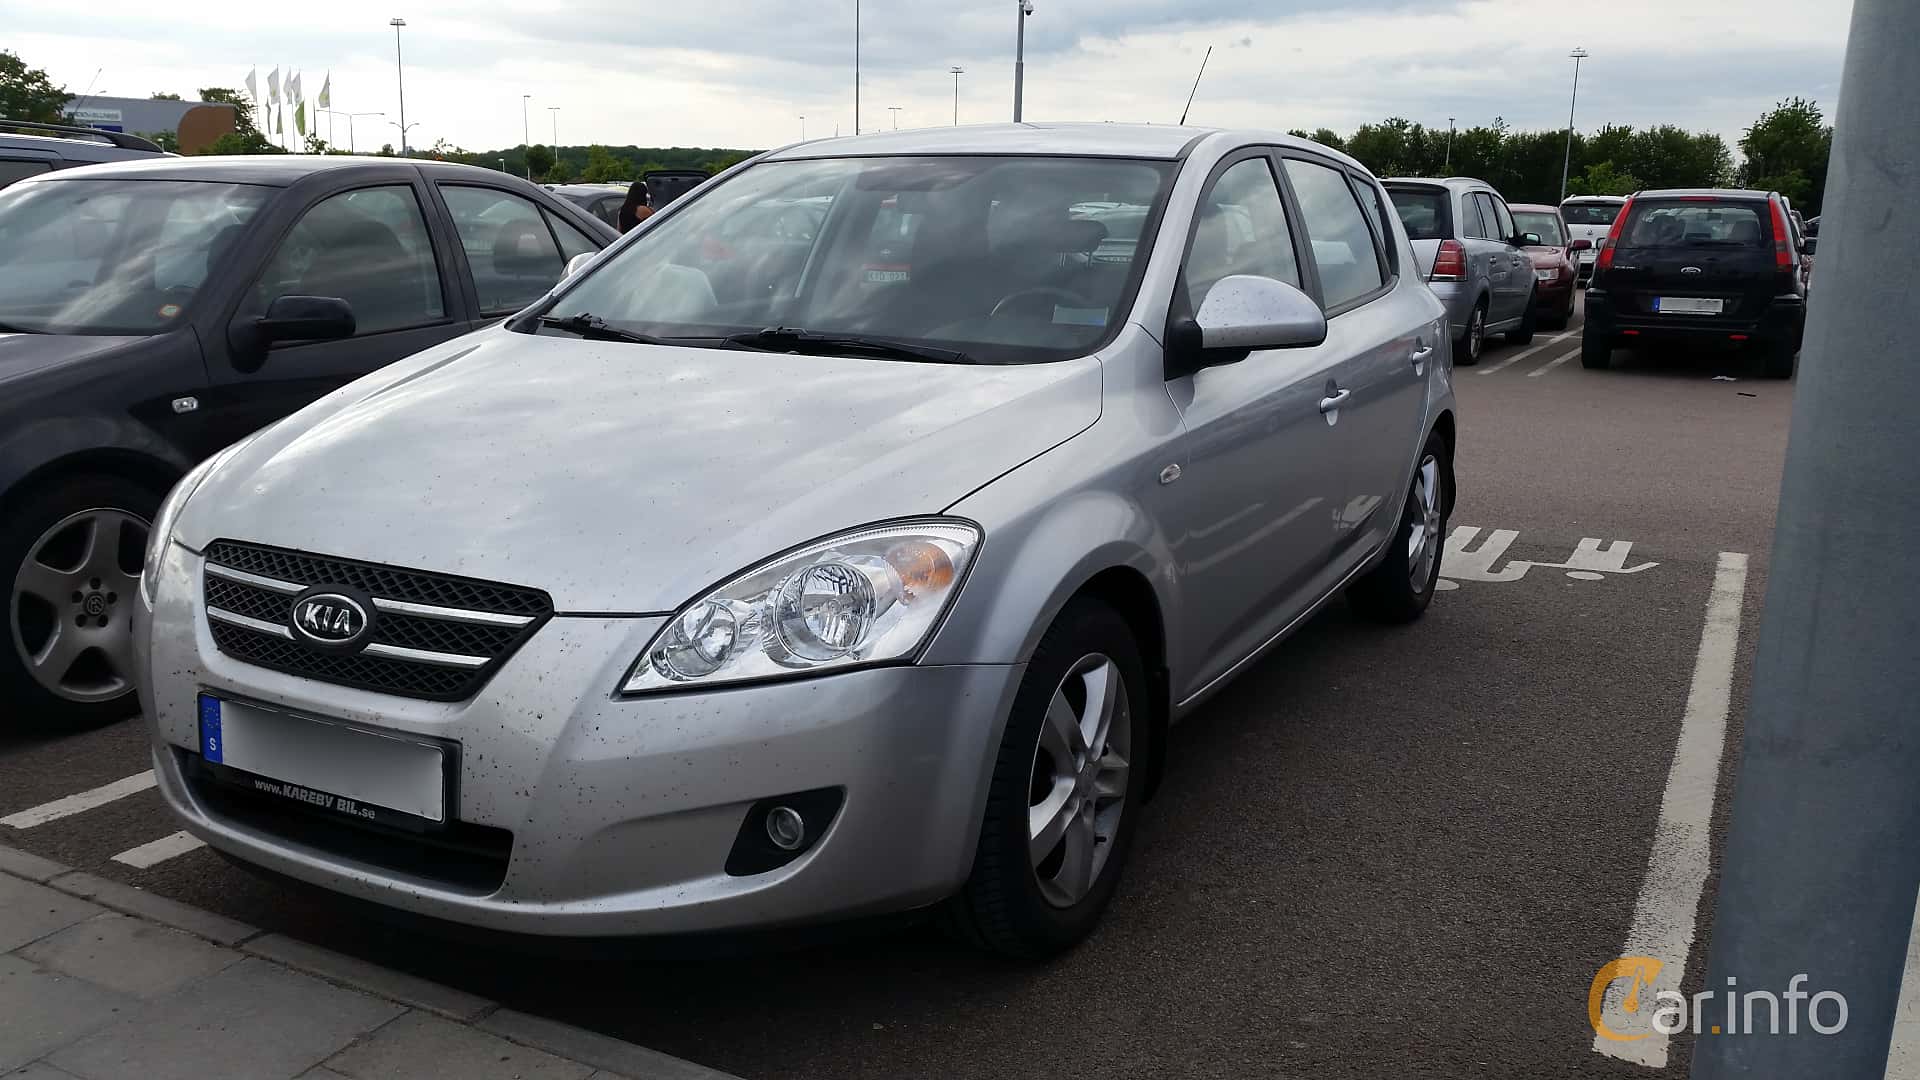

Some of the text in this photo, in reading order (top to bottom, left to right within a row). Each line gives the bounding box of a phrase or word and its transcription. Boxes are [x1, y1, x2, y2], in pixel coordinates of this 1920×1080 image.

[304, 603, 350, 635] KIA
[209, 737, 217, 751] S
[254, 779, 376, 820] www.KAREBY BIL.se
